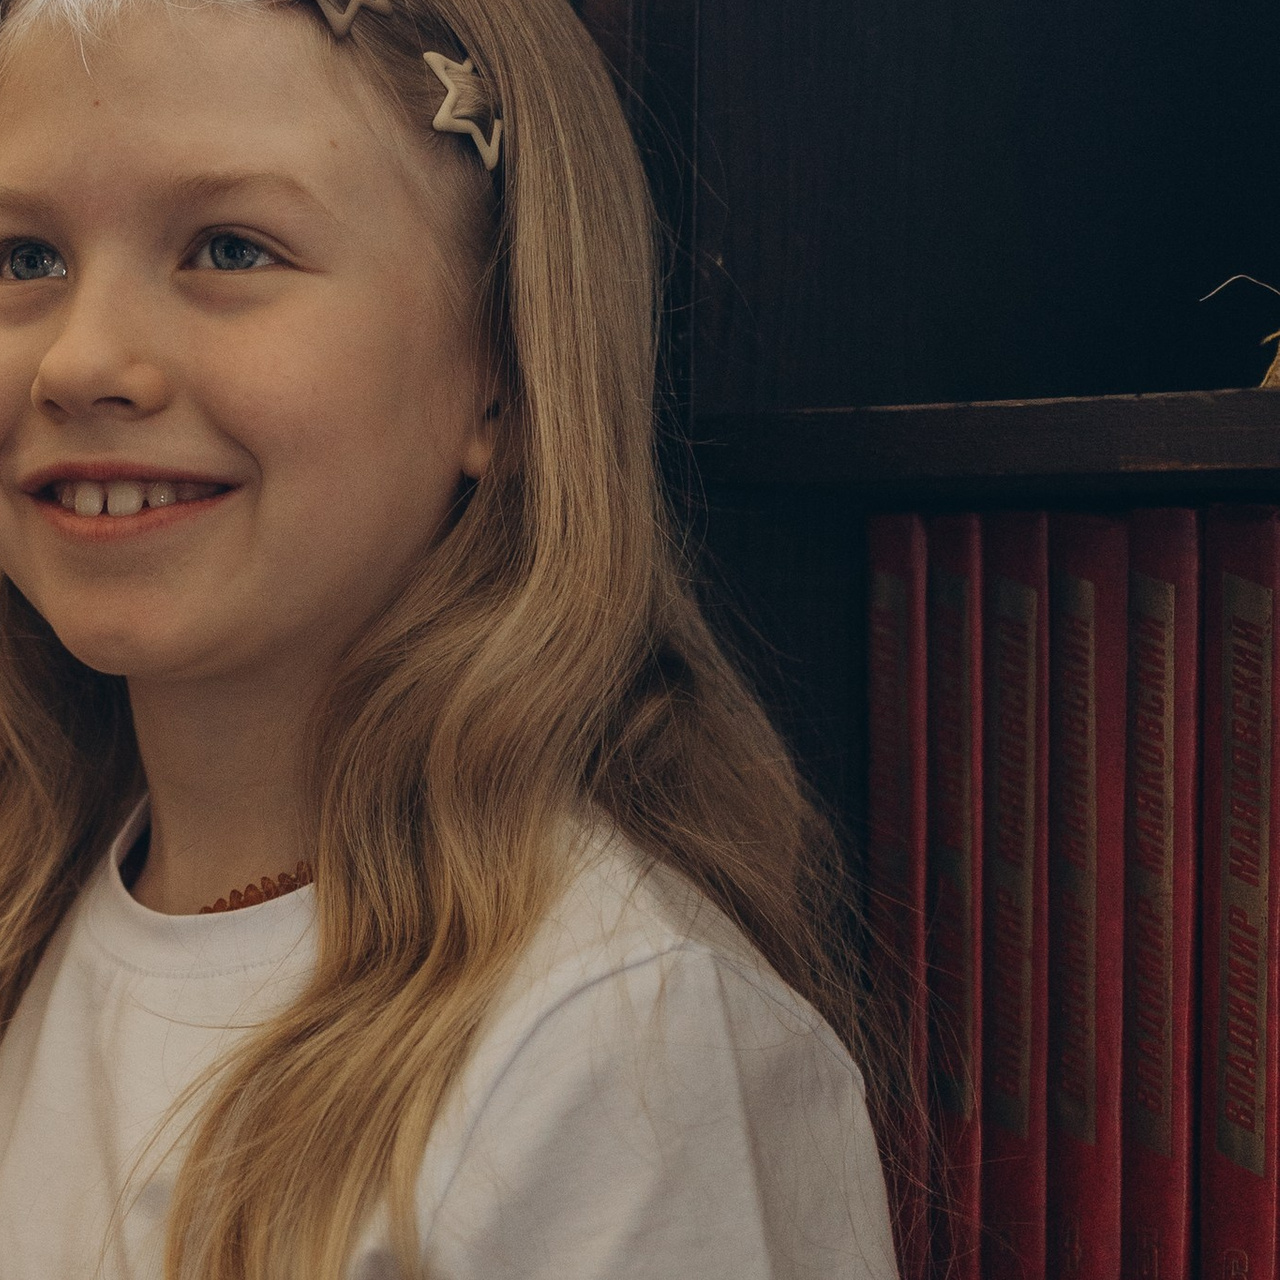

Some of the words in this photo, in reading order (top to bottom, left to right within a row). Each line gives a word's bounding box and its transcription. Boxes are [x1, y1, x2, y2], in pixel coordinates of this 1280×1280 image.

[994, 618, 1027, 866] МАЯКОВСКИЙ
[1060, 615, 1091, 870] МАЯКОВСКИЙ
[1135, 617, 1167, 876] МАЯКОВСКИЙ
[1228, 615, 1266, 887] МАЯКОВСКИЙ
[993, 888, 1023, 1098] ВЛАДИМИР
[1060, 889, 1089, 1103] ВЛАДИМИР
[1136, 896, 1166, 1113] ВЛАДИМИР
[1224, 905, 1258, 1132] ВЛАДИМИР
